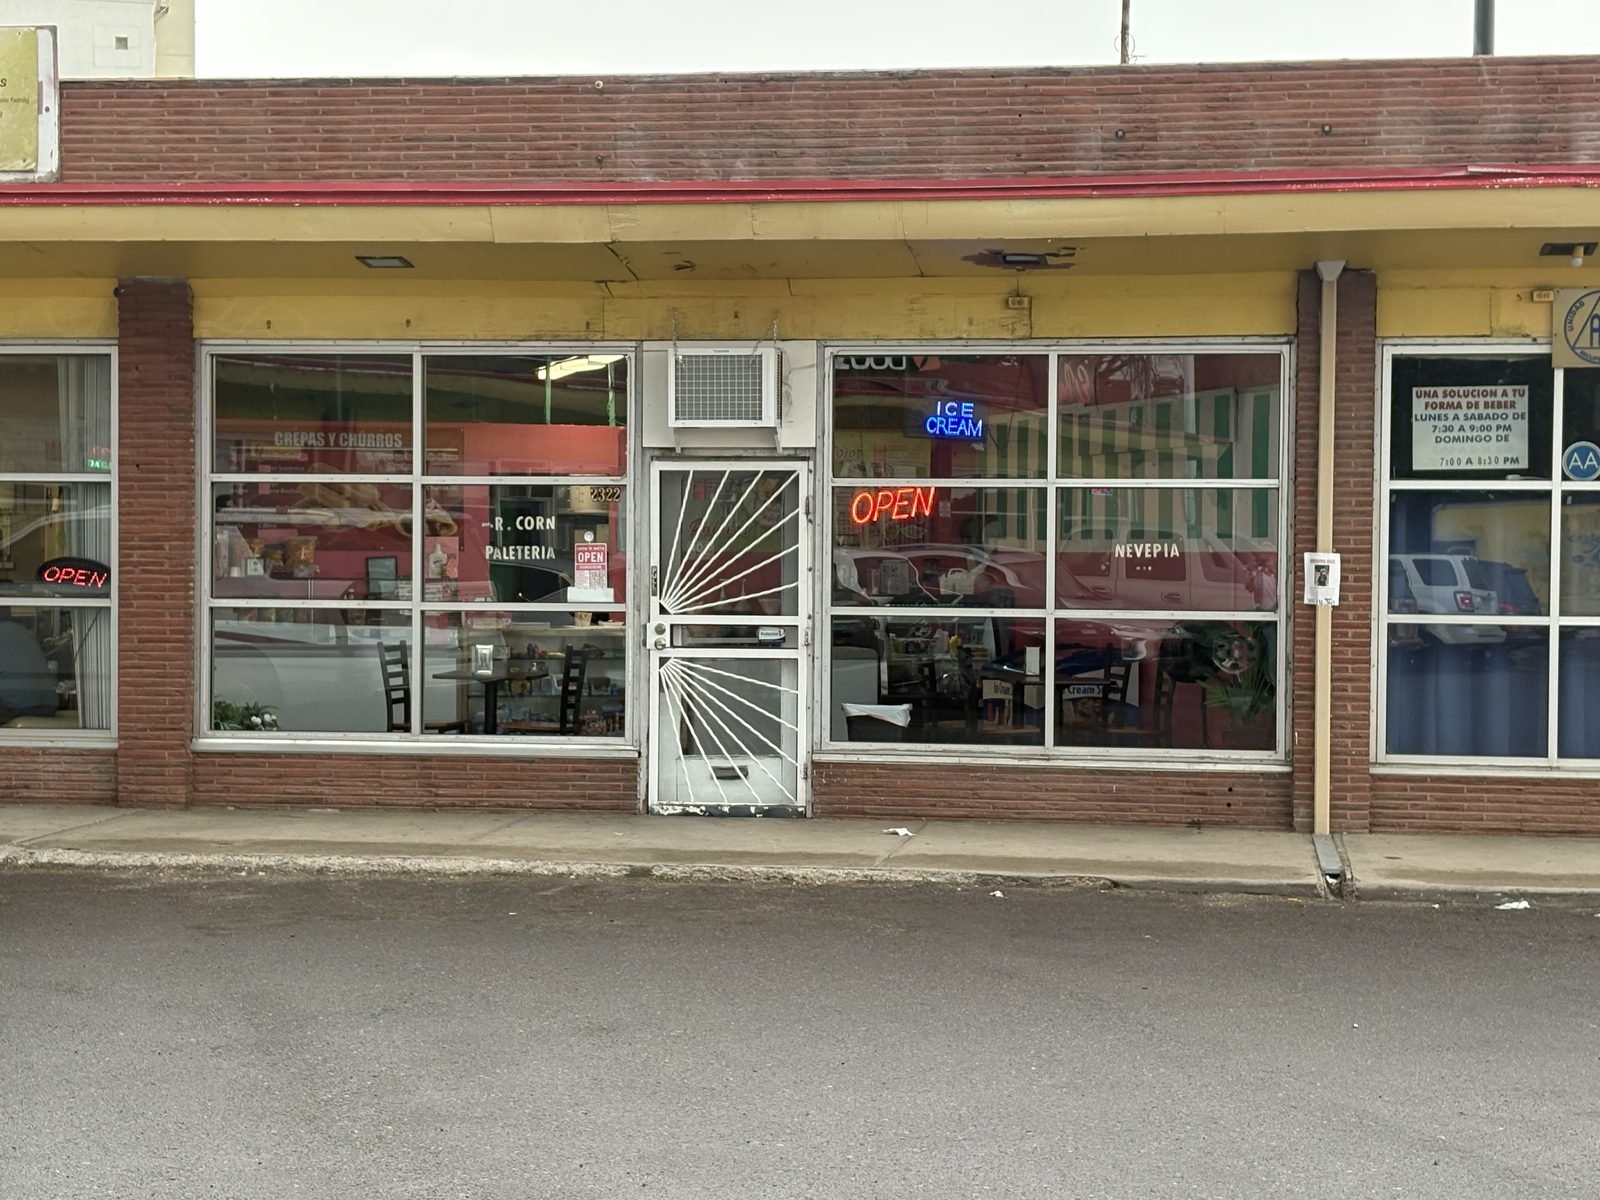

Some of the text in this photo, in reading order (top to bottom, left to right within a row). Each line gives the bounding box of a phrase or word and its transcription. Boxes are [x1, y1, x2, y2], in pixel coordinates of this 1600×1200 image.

[1567, 300, 1585, 332] UNIDAD
[1415, 388, 1526, 399] UNA SOLUCION A TU
[937, 401, 974, 417] ICE
[1424, 400, 1517, 410] FORMA DE BEBER
[1414, 412, 1527, 422] LUNES A SABADO DE
[926, 417, 983, 437] CREAM
[1431, 424, 1512, 433] 7:30 A 9:00 PM
[329, 432, 337, 447] Y
[1434, 434, 1510, 444] DOMINGO DE
[1440, 457, 1461, 466] 7:00
[1465, 457, 1473, 465] A
[1503, 456, 1520, 465] PM
[1568, 451, 1599, 470] AA
[590, 487, 621, 502] 2322
[851, 486, 936, 524] OPEN
[515, 515, 556, 531] CORN
[485, 545, 556, 560] PALETERIA
[577, 551, 605, 564] OPEN
[44, 566, 107, 587] OPEN
